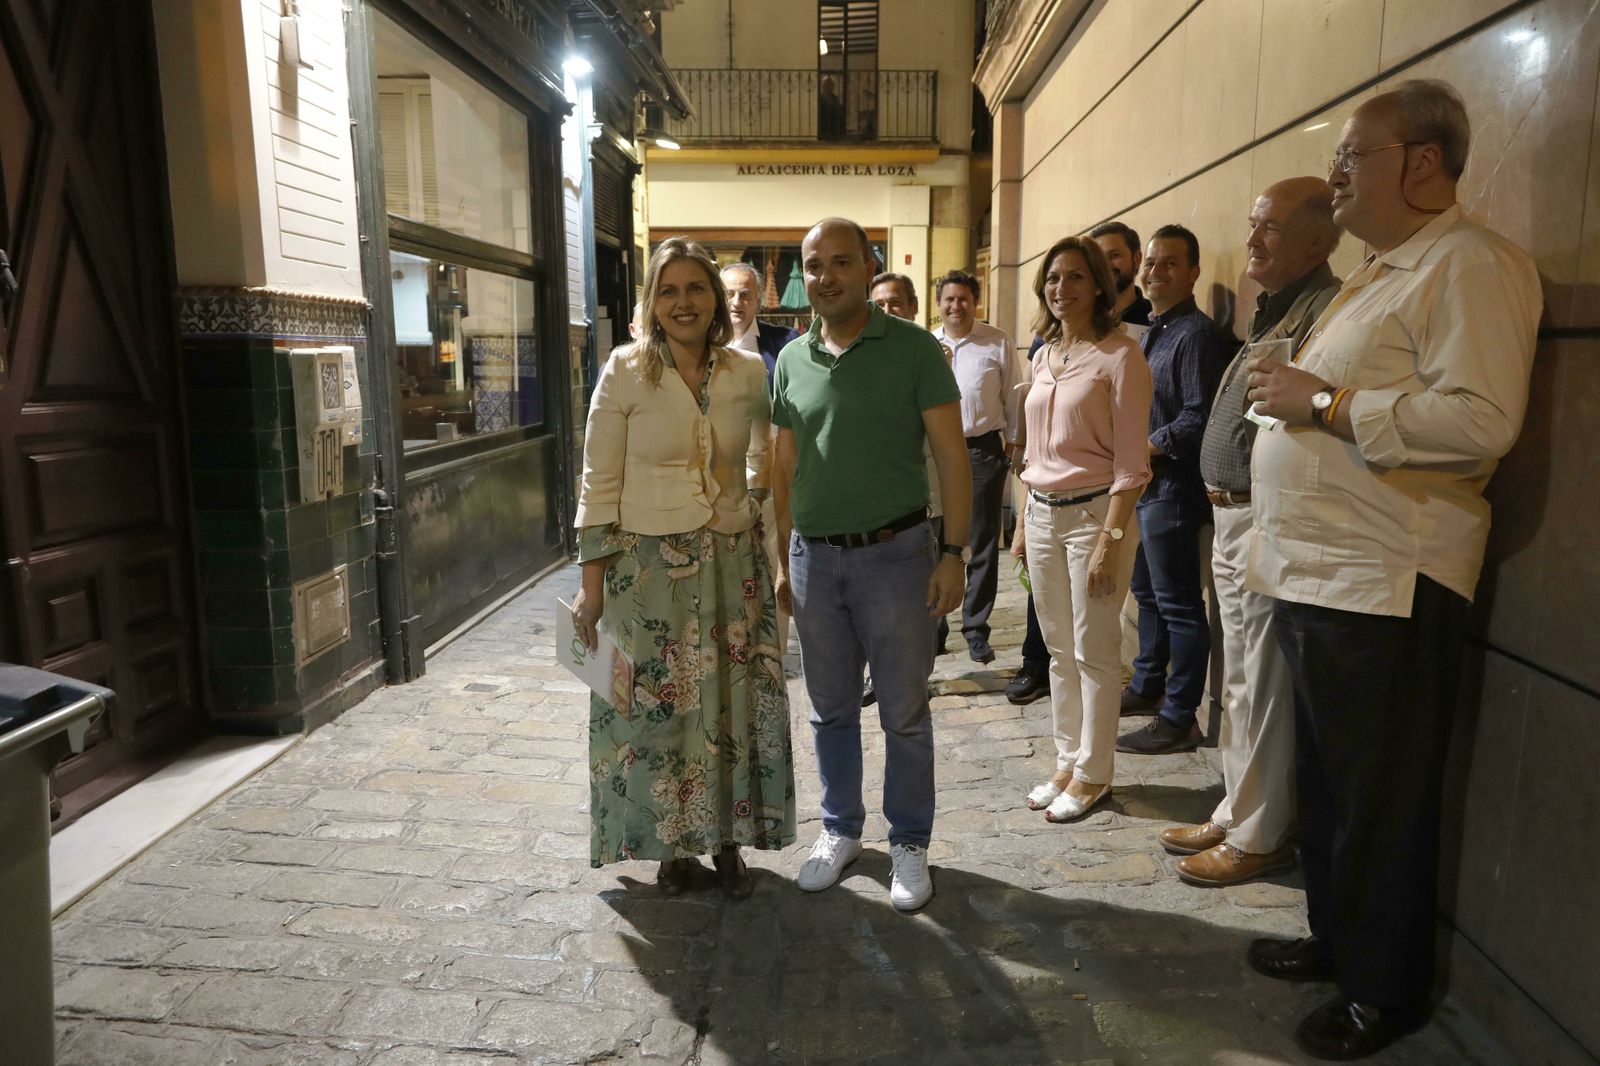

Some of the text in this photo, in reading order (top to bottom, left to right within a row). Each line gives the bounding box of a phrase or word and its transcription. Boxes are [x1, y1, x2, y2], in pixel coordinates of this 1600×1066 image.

[832, 165, 850, 176] DE
[854, 165, 872, 176] LA
[877, 165, 916, 177] LOZA
[570, 633, 587, 667] VO
